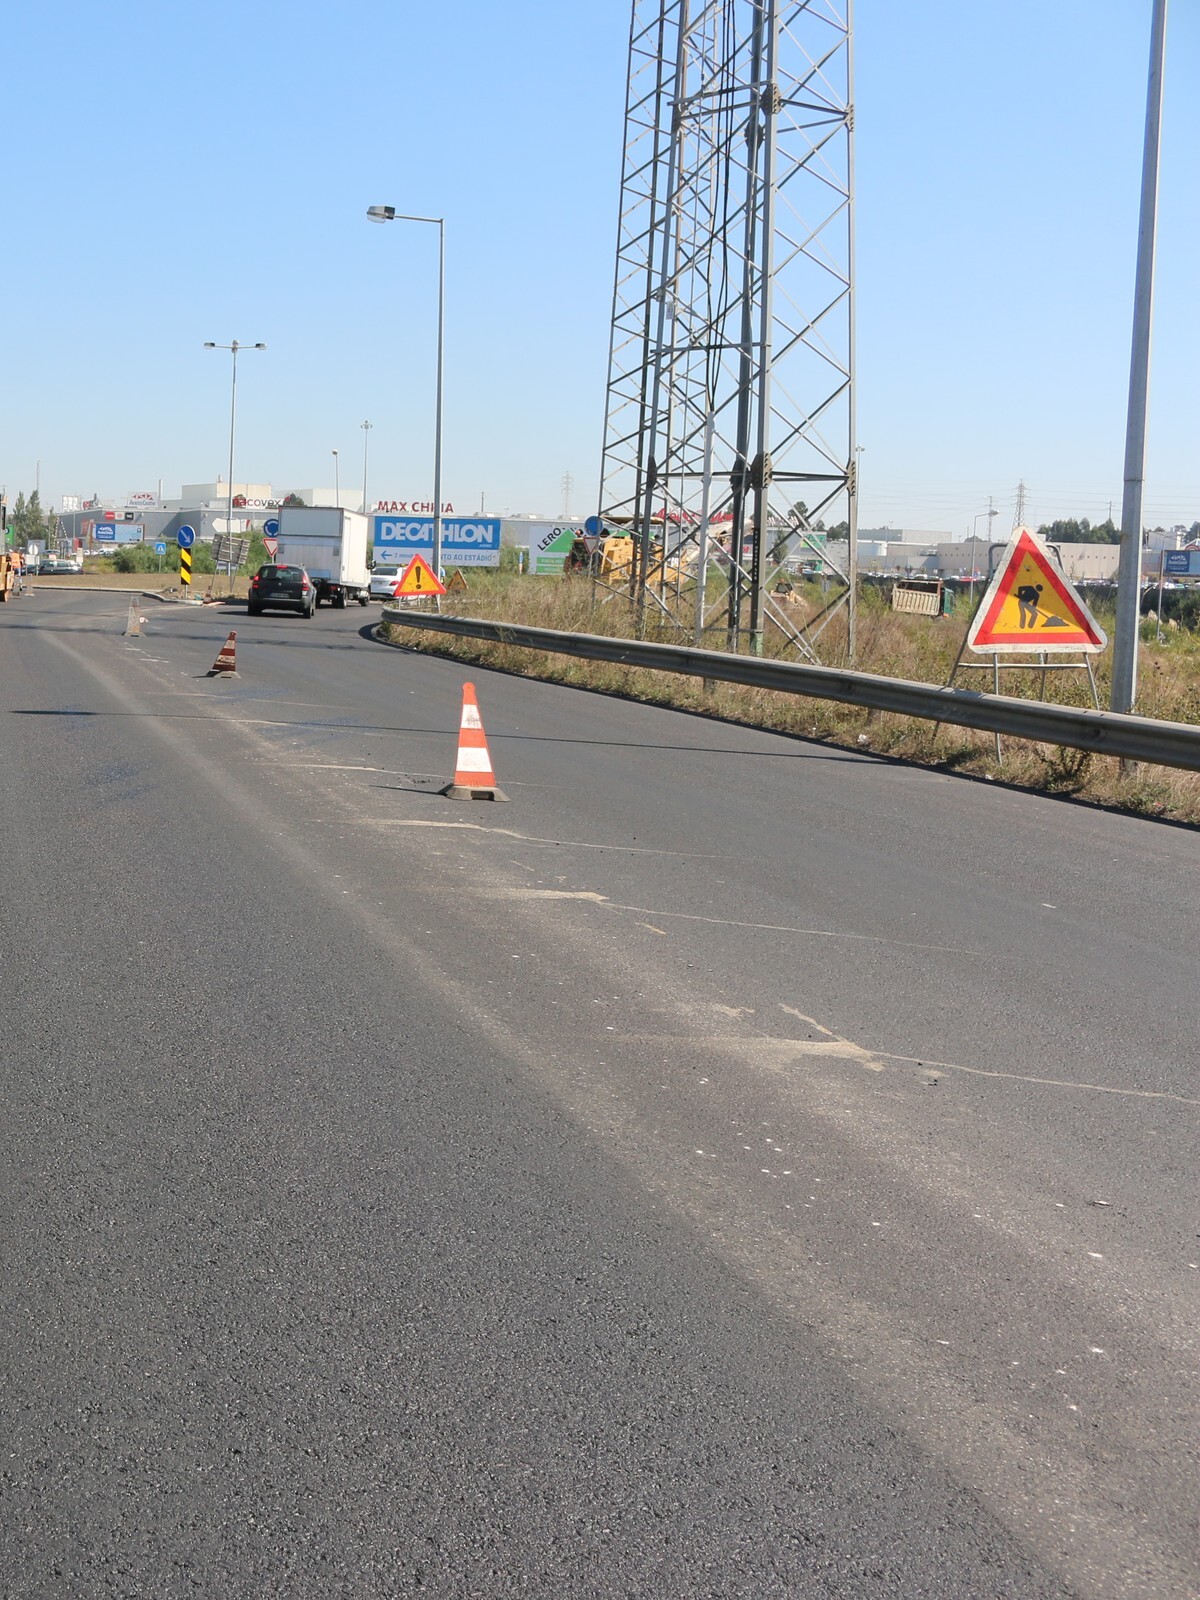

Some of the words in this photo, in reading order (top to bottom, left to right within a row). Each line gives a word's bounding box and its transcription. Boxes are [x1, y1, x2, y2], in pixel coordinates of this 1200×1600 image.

[378, 500, 407, 511] MAX
[453, 553, 463, 561] AO
[464, 553, 493, 561] ESTÁDIO
